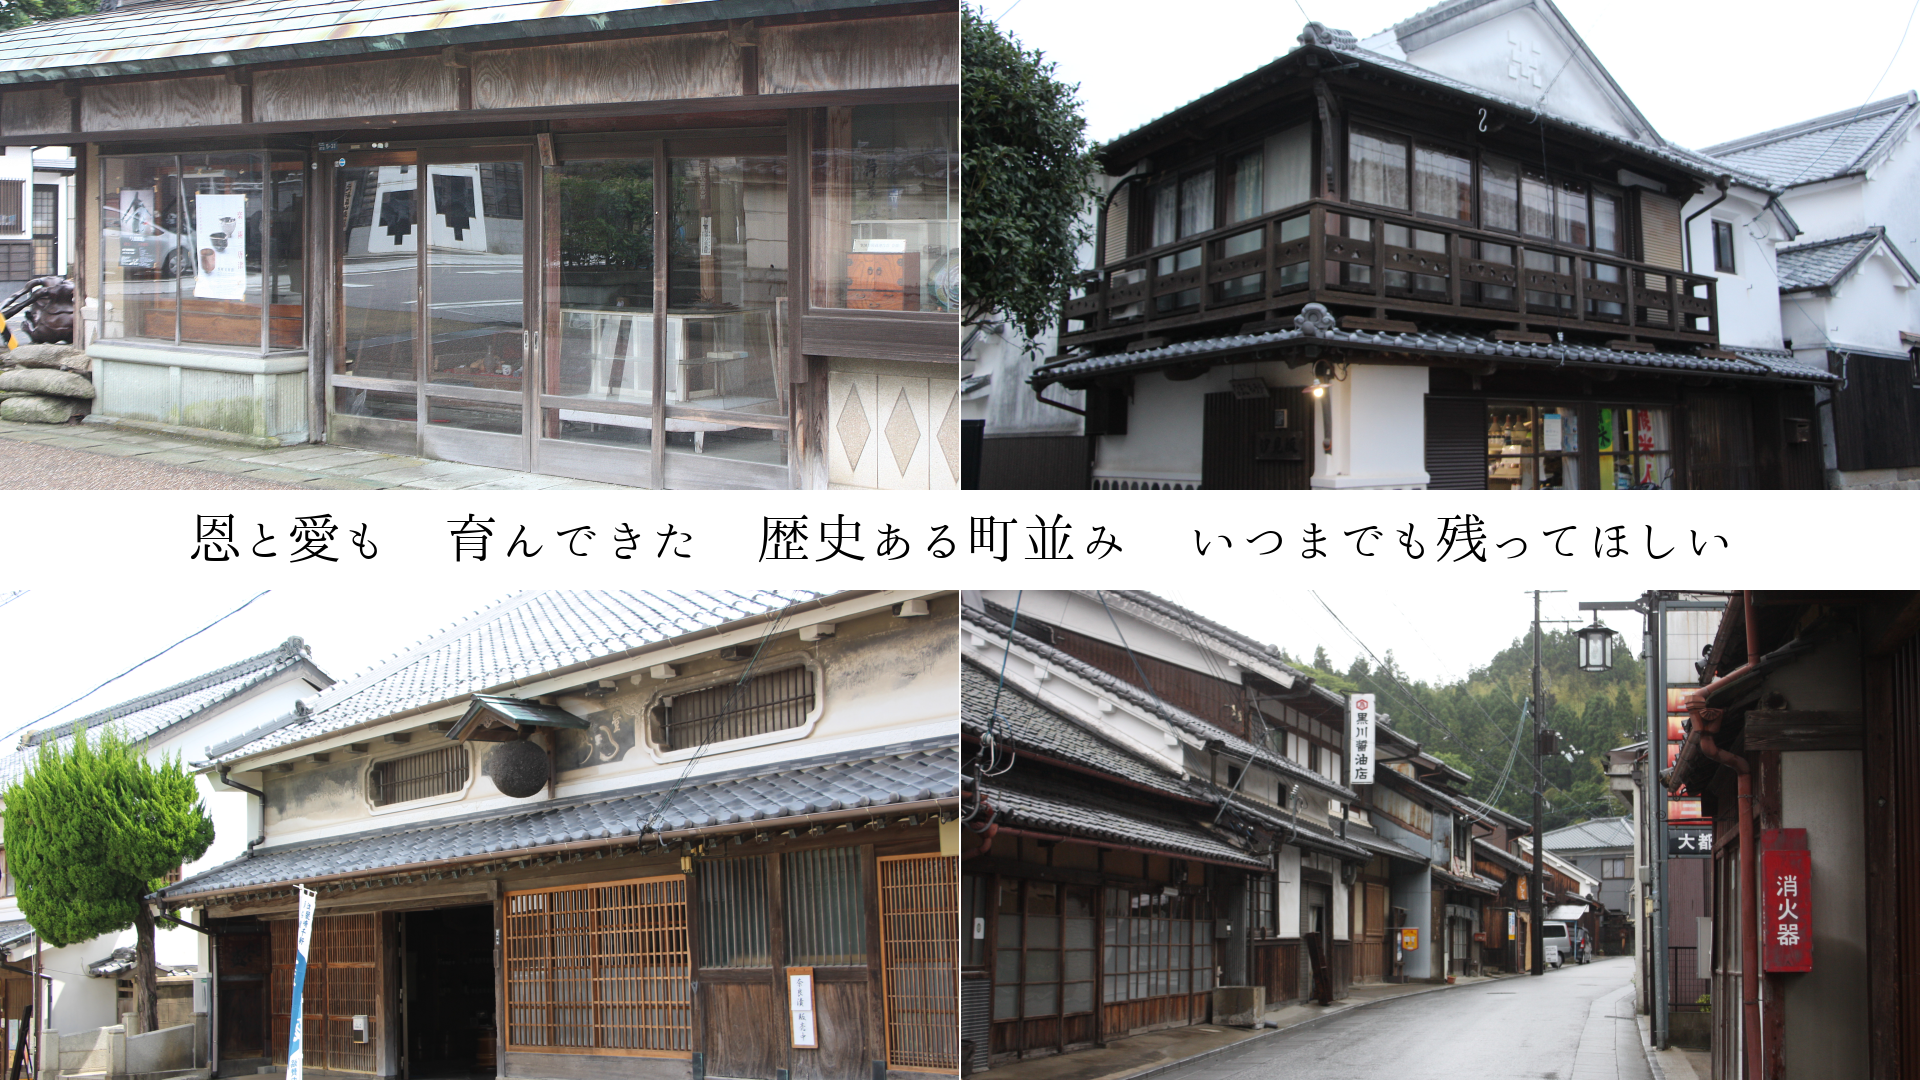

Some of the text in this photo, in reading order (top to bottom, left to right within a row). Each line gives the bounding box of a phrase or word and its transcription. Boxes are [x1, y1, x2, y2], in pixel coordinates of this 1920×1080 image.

[1355, 712, 1369, 780] 黒川醤油店
[1776, 874, 1800, 946] 消火器
